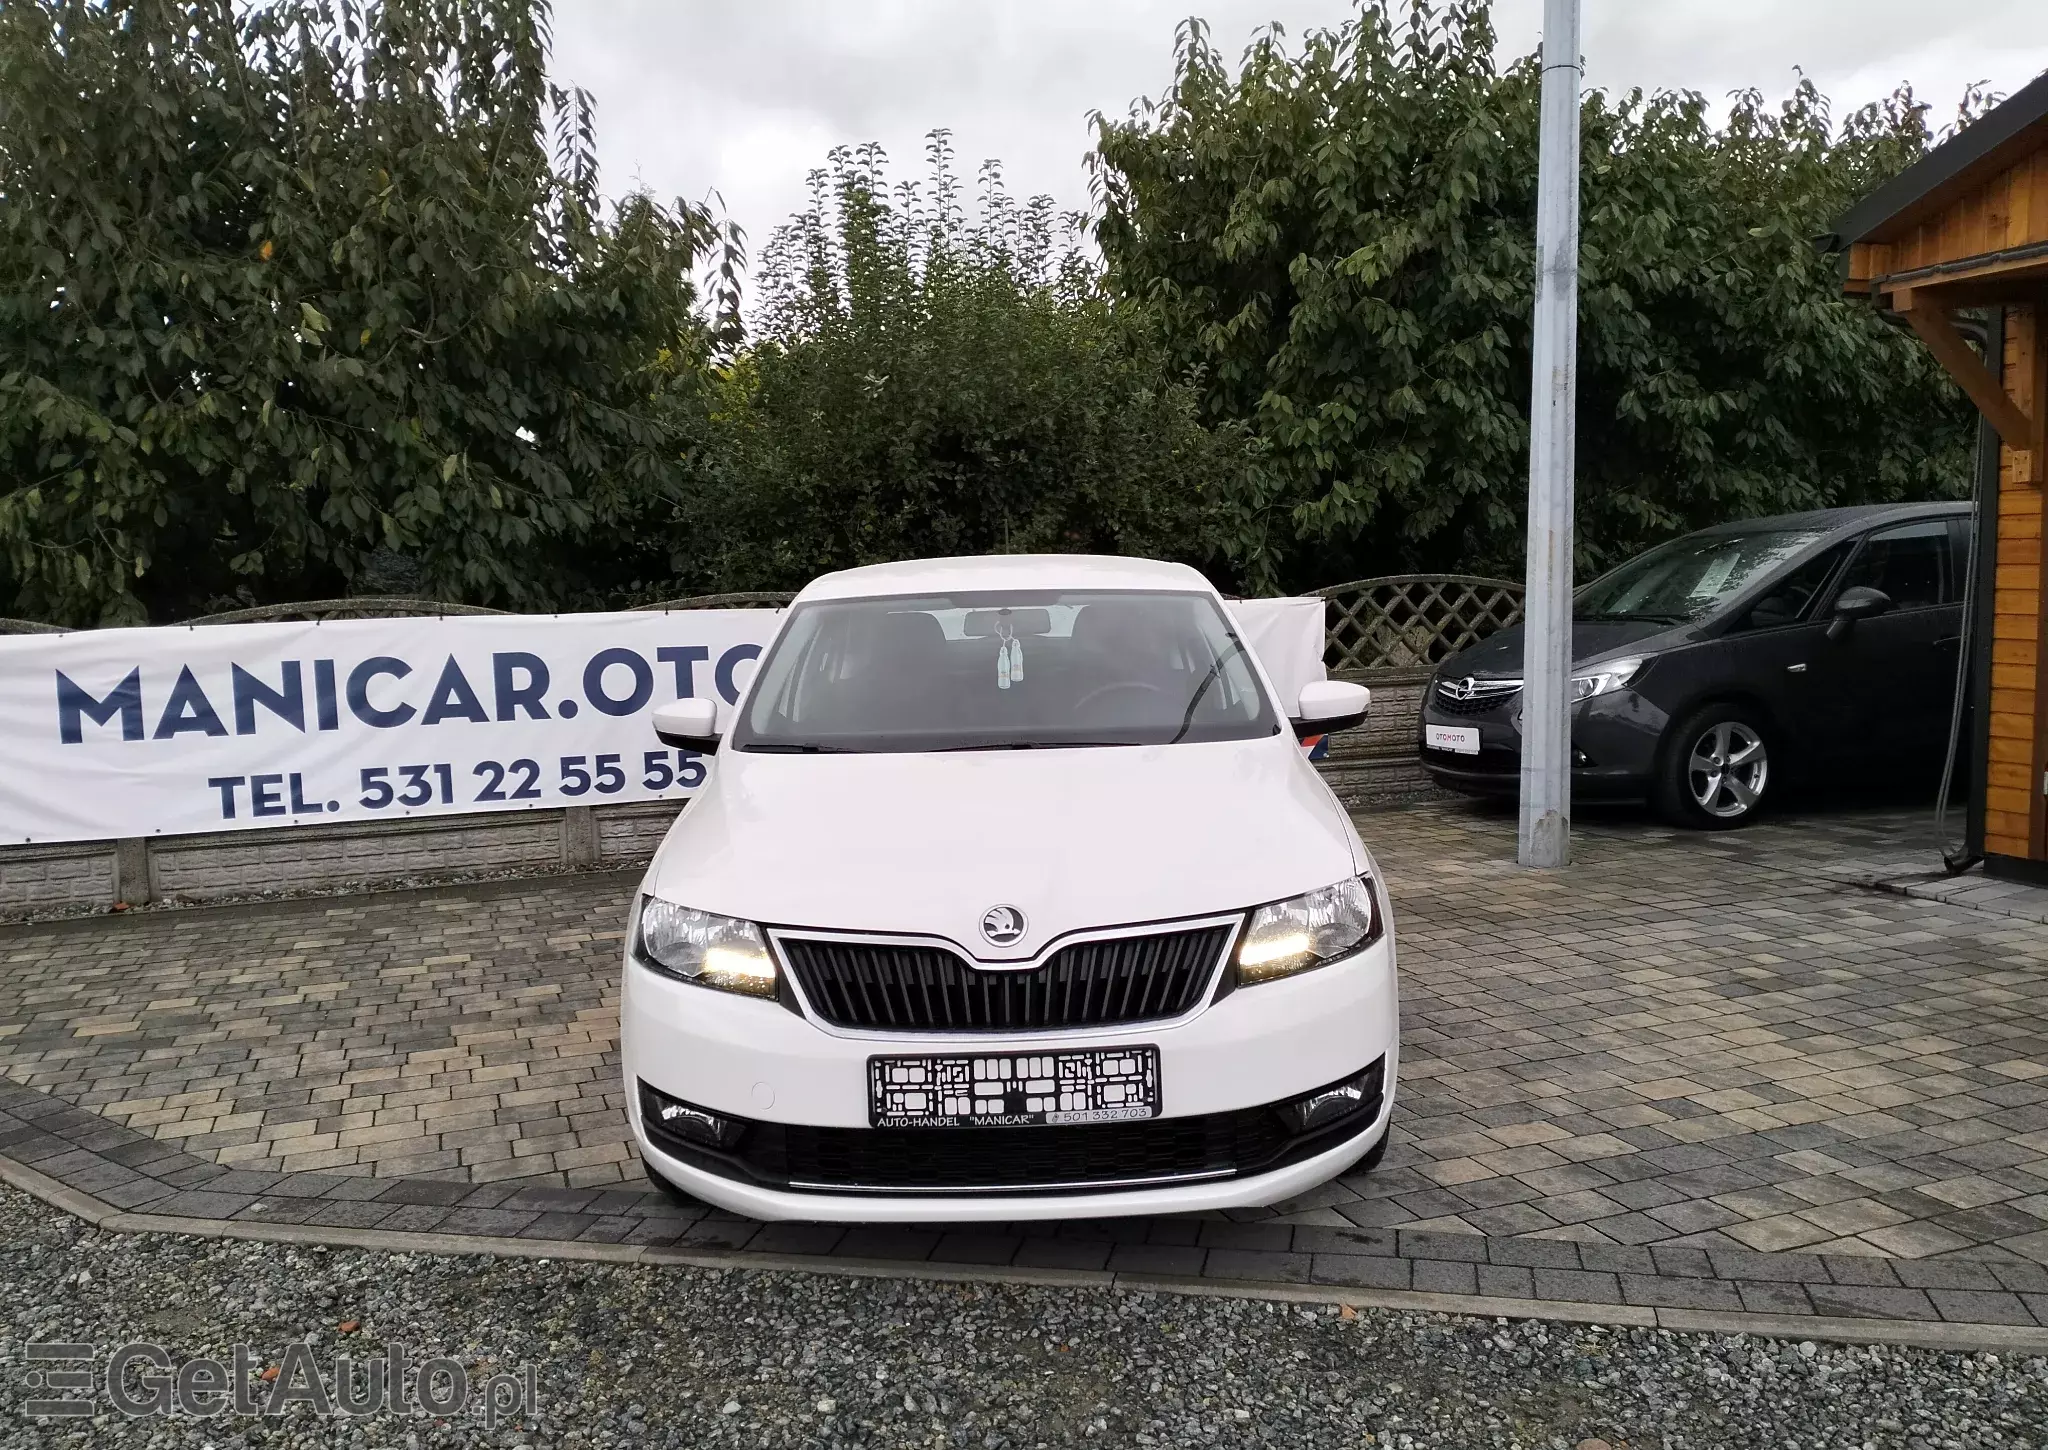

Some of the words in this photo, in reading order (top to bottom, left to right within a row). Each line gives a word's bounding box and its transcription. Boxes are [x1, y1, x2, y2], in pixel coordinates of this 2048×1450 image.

[1436, 733, 1466, 742] OTOMOTO
[207, 772, 340, 820] TEL.
[359, 763, 454, 810] 531
[473, 758, 542, 803] 22
[559, 753, 626, 797] 55
[642, 749, 707, 790] 55
[877, 1116, 960, 1127] AUTO-HANDEL
[969, 1114, 1034, 1126] "MANICAR"
[1063, 1112, 1088, 1122] 501
[1092, 1109, 1118, 1121] 332
[1121, 1107, 1147, 1119] 703
